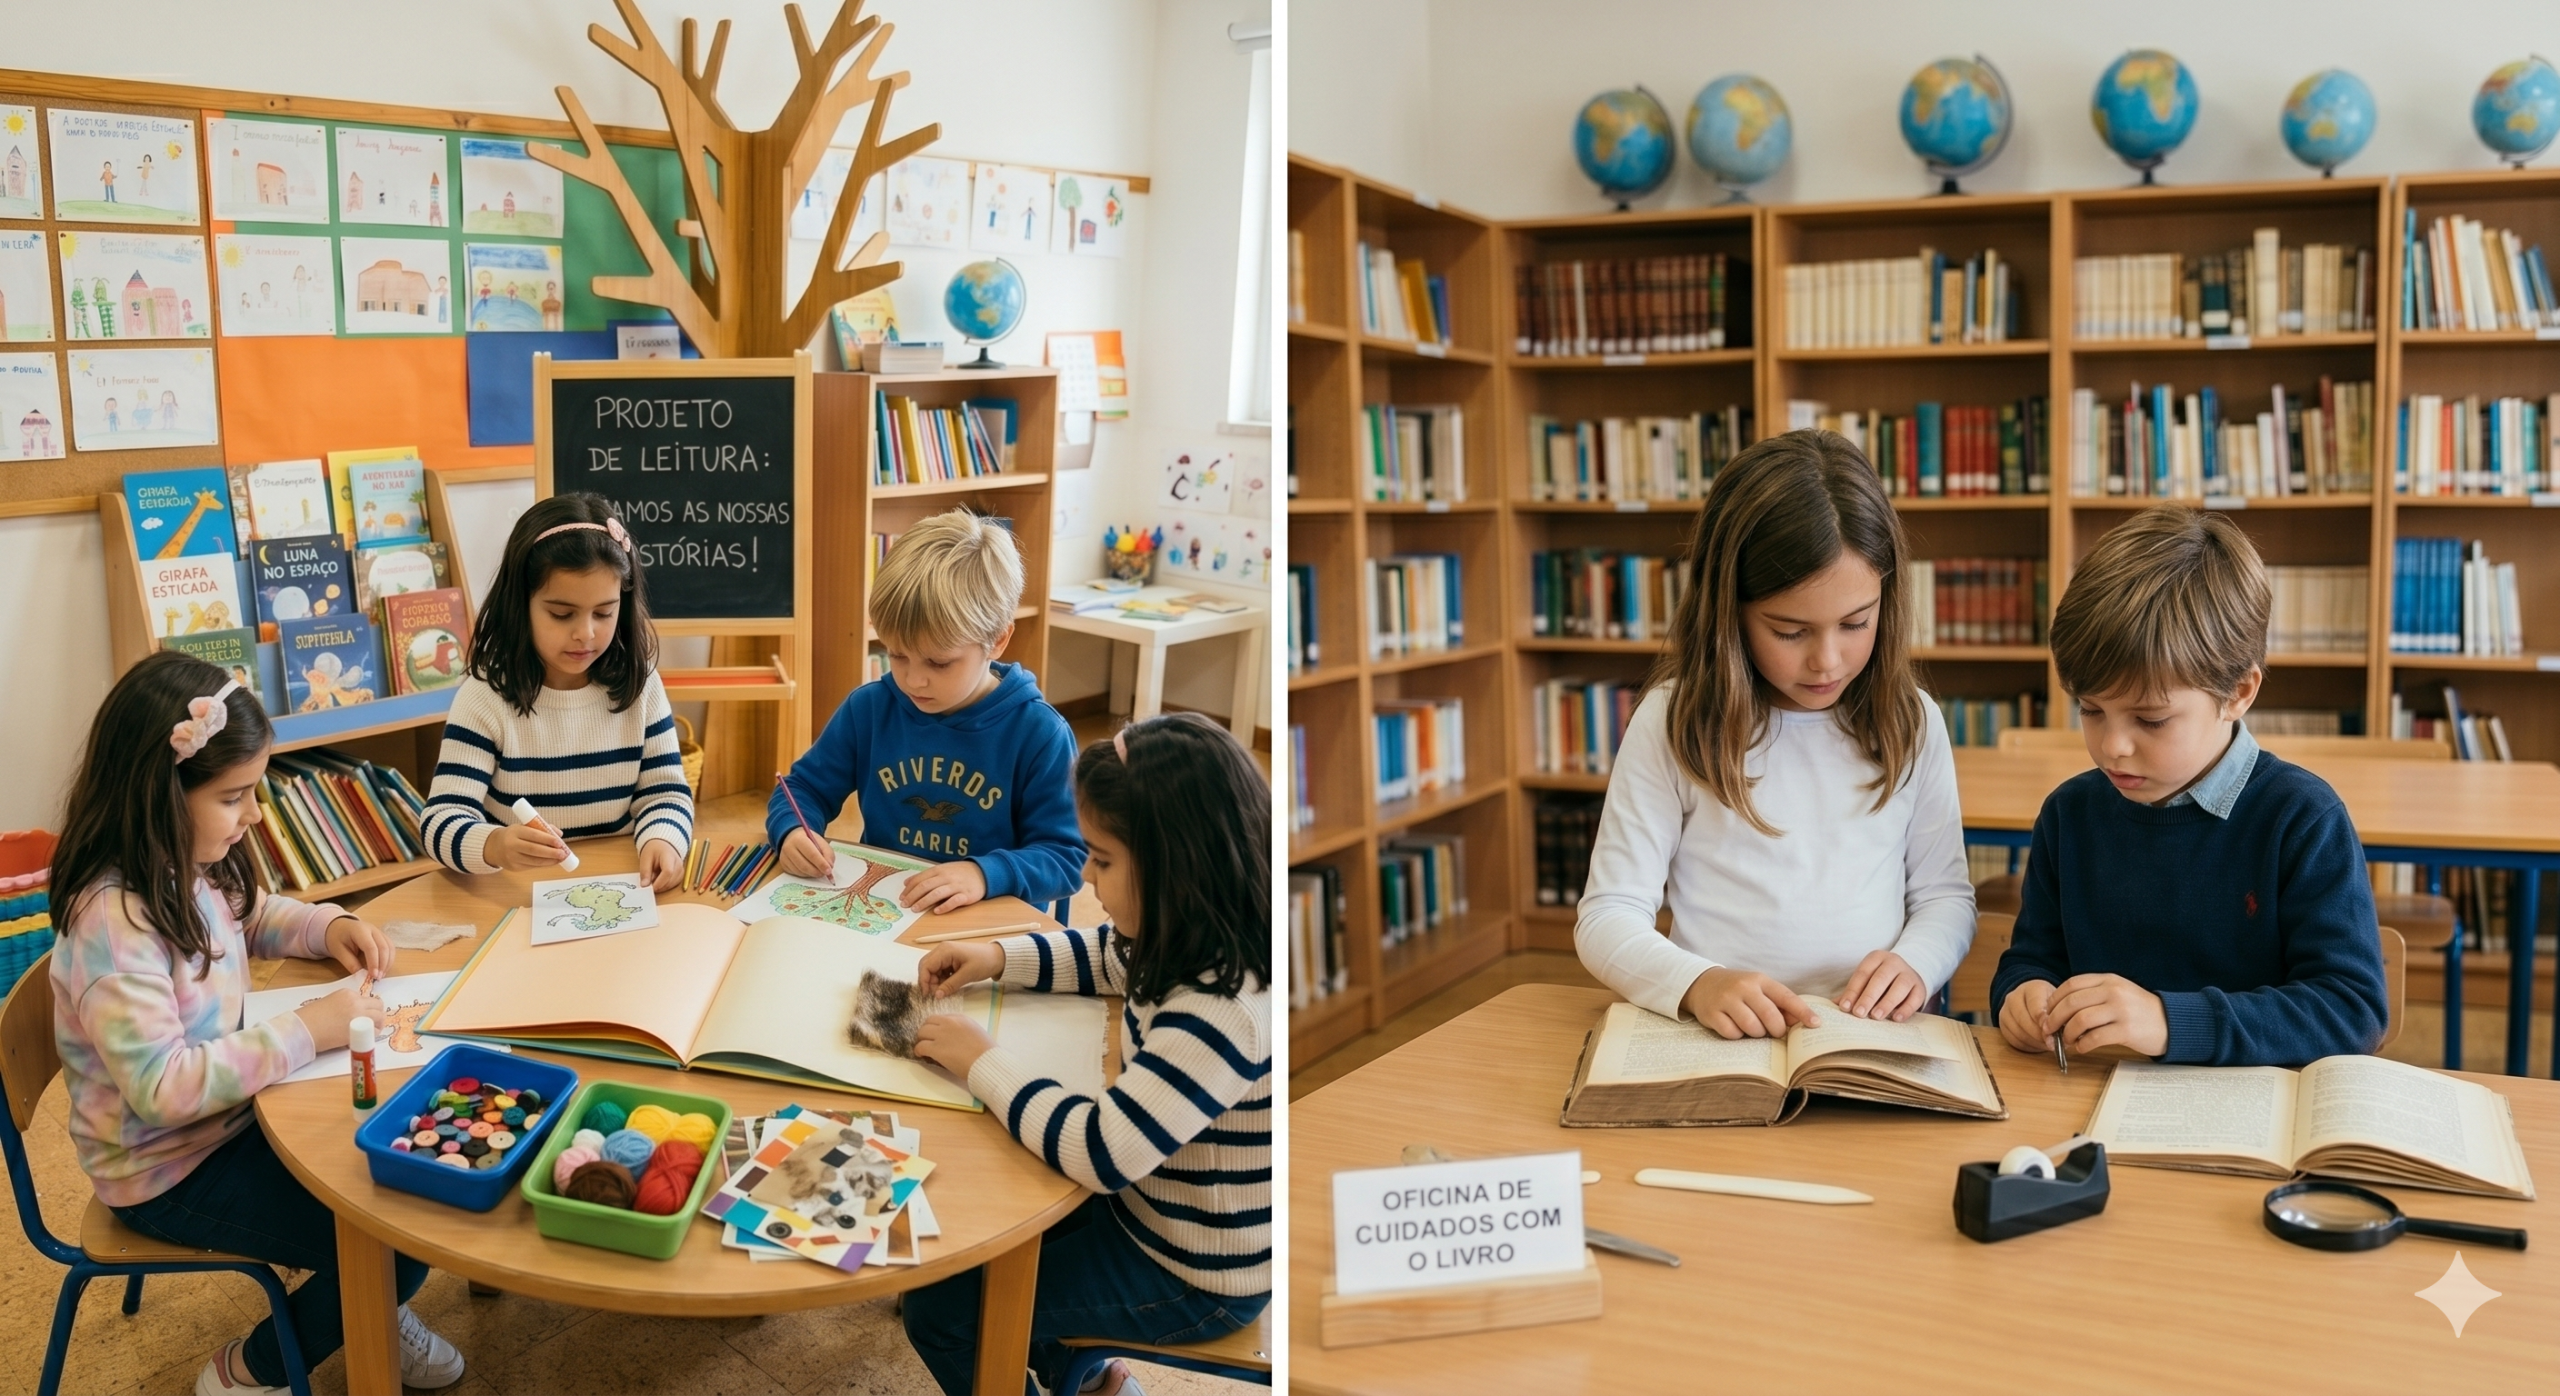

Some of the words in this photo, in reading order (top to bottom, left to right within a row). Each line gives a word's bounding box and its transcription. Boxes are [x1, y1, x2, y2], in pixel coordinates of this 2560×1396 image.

[594, 396, 733, 429] PROJETO
[587, 446, 624, 472] DE
[613, 500, 674, 523] AMOS
[682, 500, 710, 523] AS
[717, 501, 790, 525] NOSSAS
[283, 547, 319, 563] LUNA
[639, 535, 758, 573] STÓRIAS!
[158, 566, 209, 583] GIRAFA
[263, 565, 285, 580] NO
[290, 560, 339, 578] ESPAÇO
[152, 580, 219, 598] ESTICADA
[877, 756, 1003, 811] RIVERDS
[899, 826, 969, 857] CARLS
[1382, 1184, 1490, 1211] OFICINA
[1499, 1179, 1533, 1201] DE
[1355, 1214, 1494, 1245] CUIDADOS
[1502, 1207, 1562, 1231] COM
[1408, 1251, 1427, 1272] O
[1436, 1243, 1515, 1269] LIVRO
